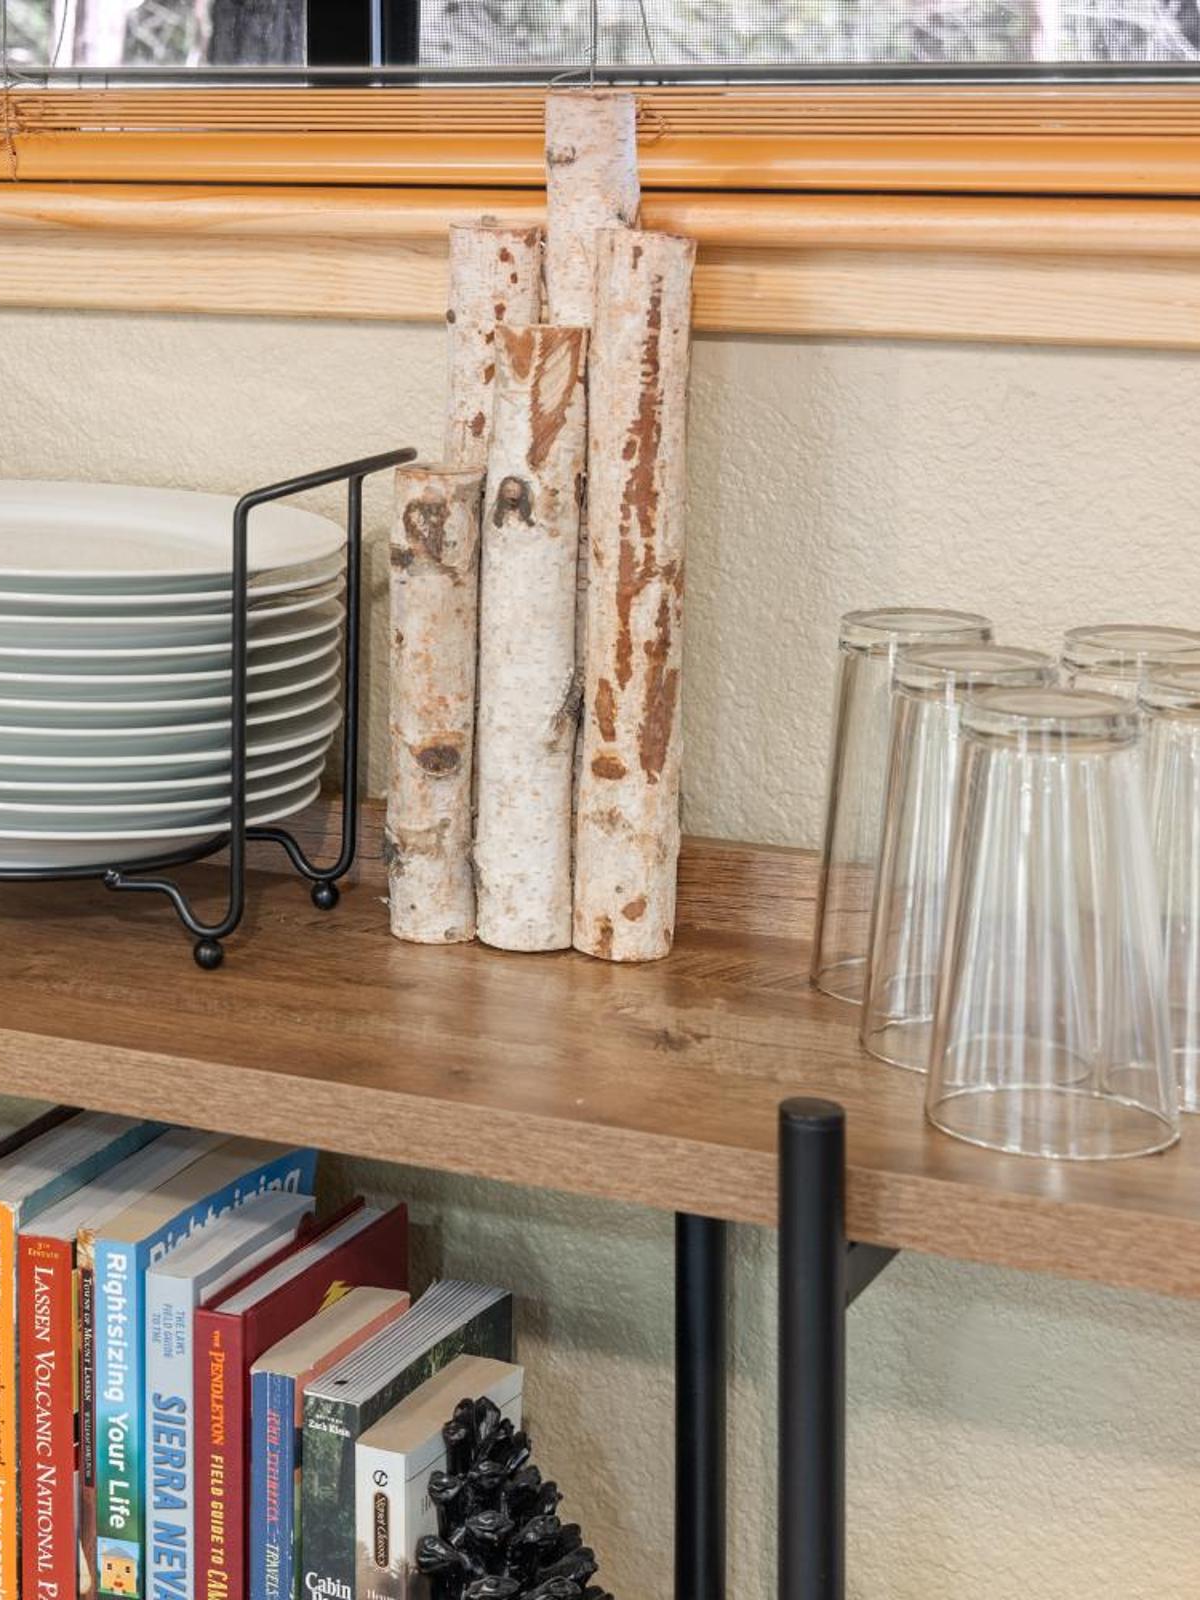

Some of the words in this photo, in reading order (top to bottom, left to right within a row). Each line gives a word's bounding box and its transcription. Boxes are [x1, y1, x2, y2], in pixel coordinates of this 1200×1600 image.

[34, 1264, 54, 1342] LASSEN
[102, 1252, 128, 1403] Rightsizing
[34, 1350, 56, 1457] VOLCANIC
[208, 1350, 225, 1446] PENDLETON
[107, 1412, 129, 1472] Your
[152, 1392, 187, 1510] SIERRA
[210, 1453, 225, 1497] FIELD
[36, 1461, 57, 1572] NATIONAL
[108, 1479, 131, 1529] Life
[210, 1500, 225, 1545] GUIDE
[152, 1520, 187, 1600] NEVA
[210, 1547, 225, 1566] TO
[265, 1543, 280, 1599] TRAVELS
[305, 1571, 352, 1600] Cabin
